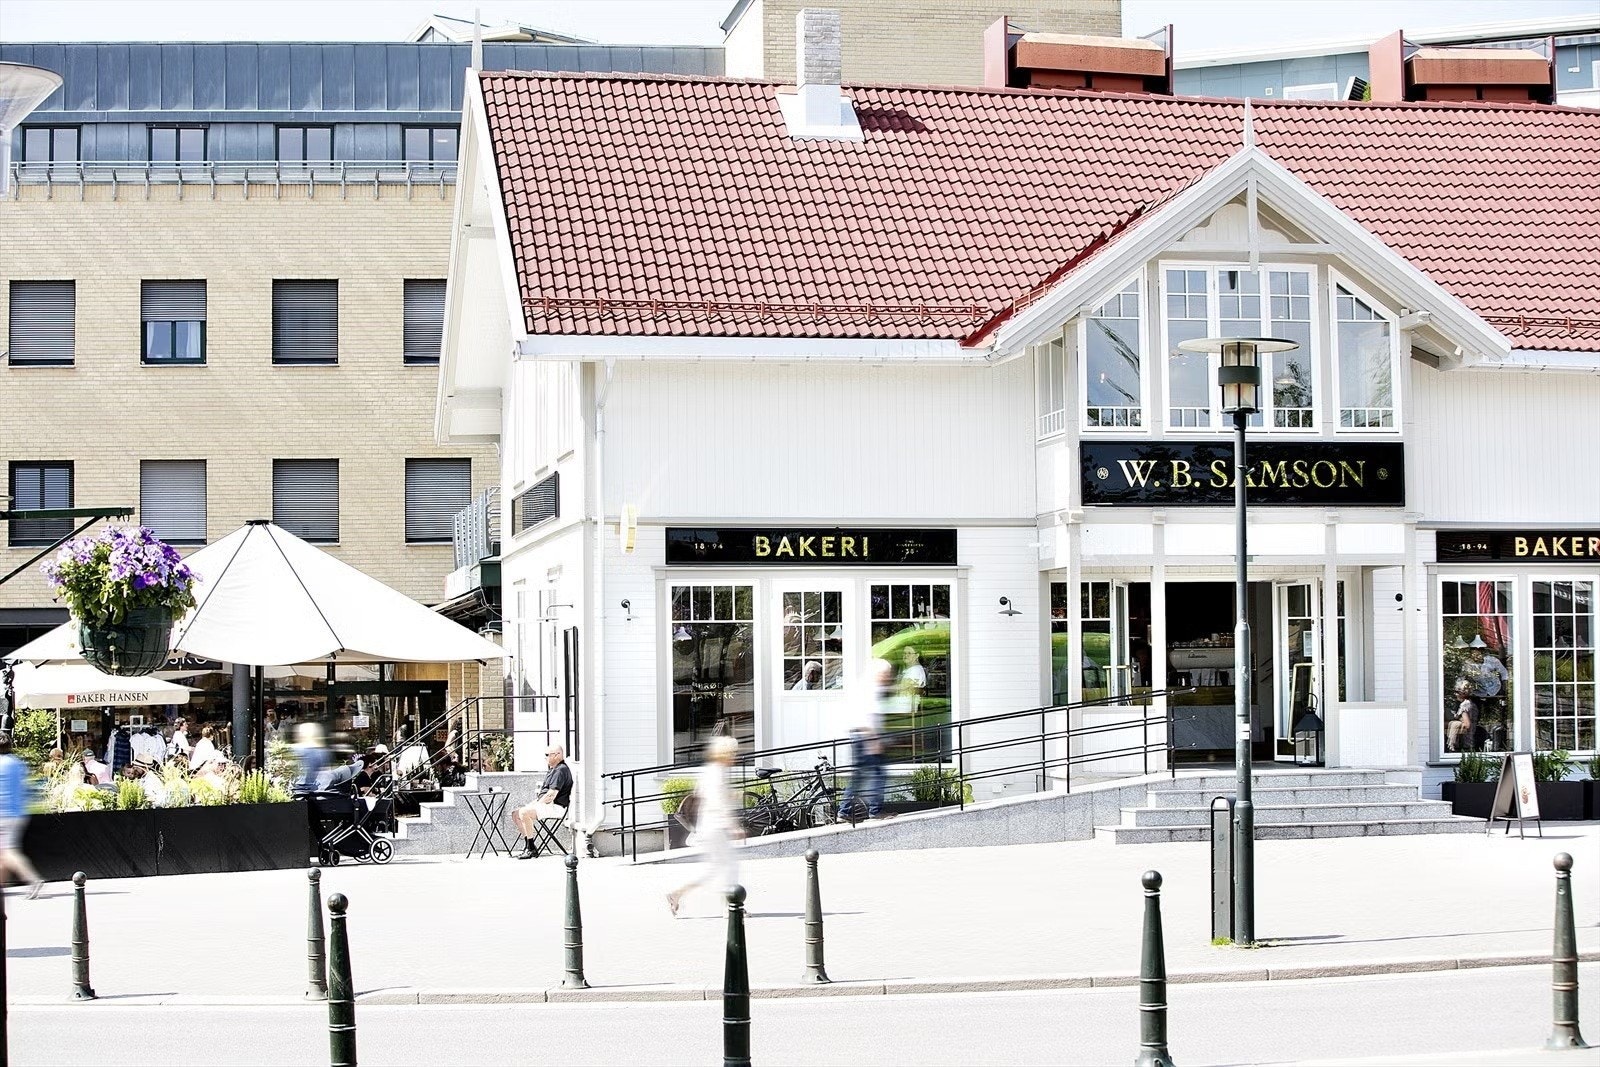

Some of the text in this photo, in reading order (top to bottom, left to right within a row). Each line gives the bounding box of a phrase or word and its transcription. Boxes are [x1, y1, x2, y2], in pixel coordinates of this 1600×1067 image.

[1116, 459, 1161, 488] W.
[1170, 459, 1201, 488] B.
[755, 535, 869, 557] BAKERI
[1514, 536, 1600, 557] BAKER
[76, 691, 149, 704] BAKER HANSEN
